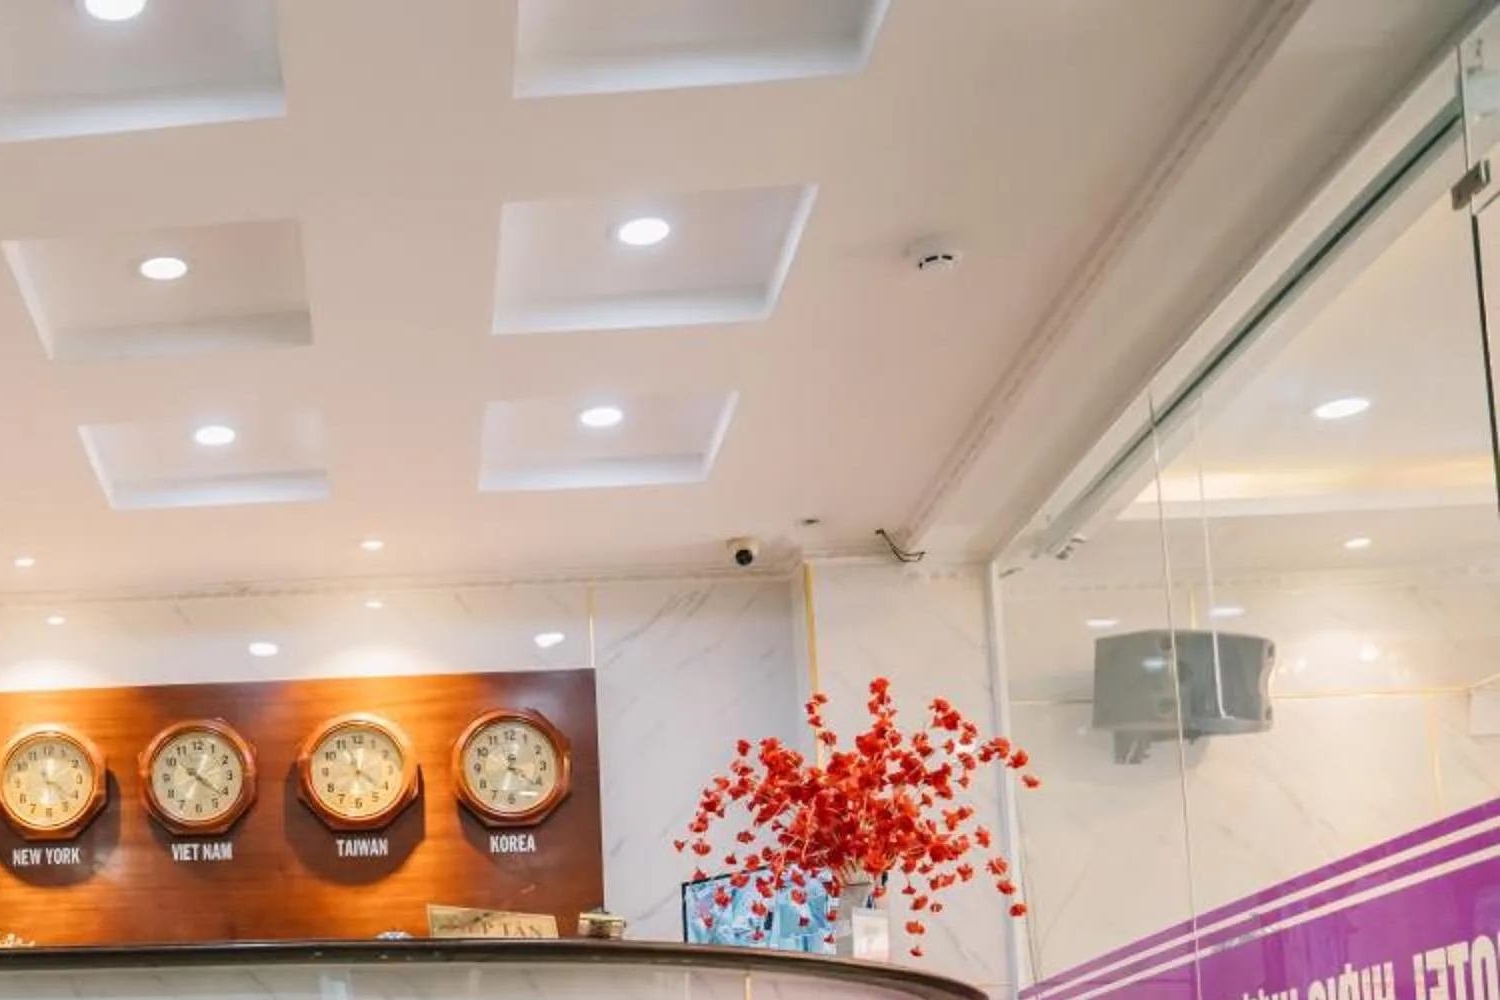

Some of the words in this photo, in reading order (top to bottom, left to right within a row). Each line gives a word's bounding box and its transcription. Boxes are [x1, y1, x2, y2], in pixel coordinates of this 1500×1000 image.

[171, 843, 200, 861] VIET
[203, 842, 233, 861] NAM
[336, 838, 389, 856] TAIWAN
[489, 834, 536, 853] KOREA
[12, 848, 42, 867] NEW
[45, 847, 80, 864] YORK
